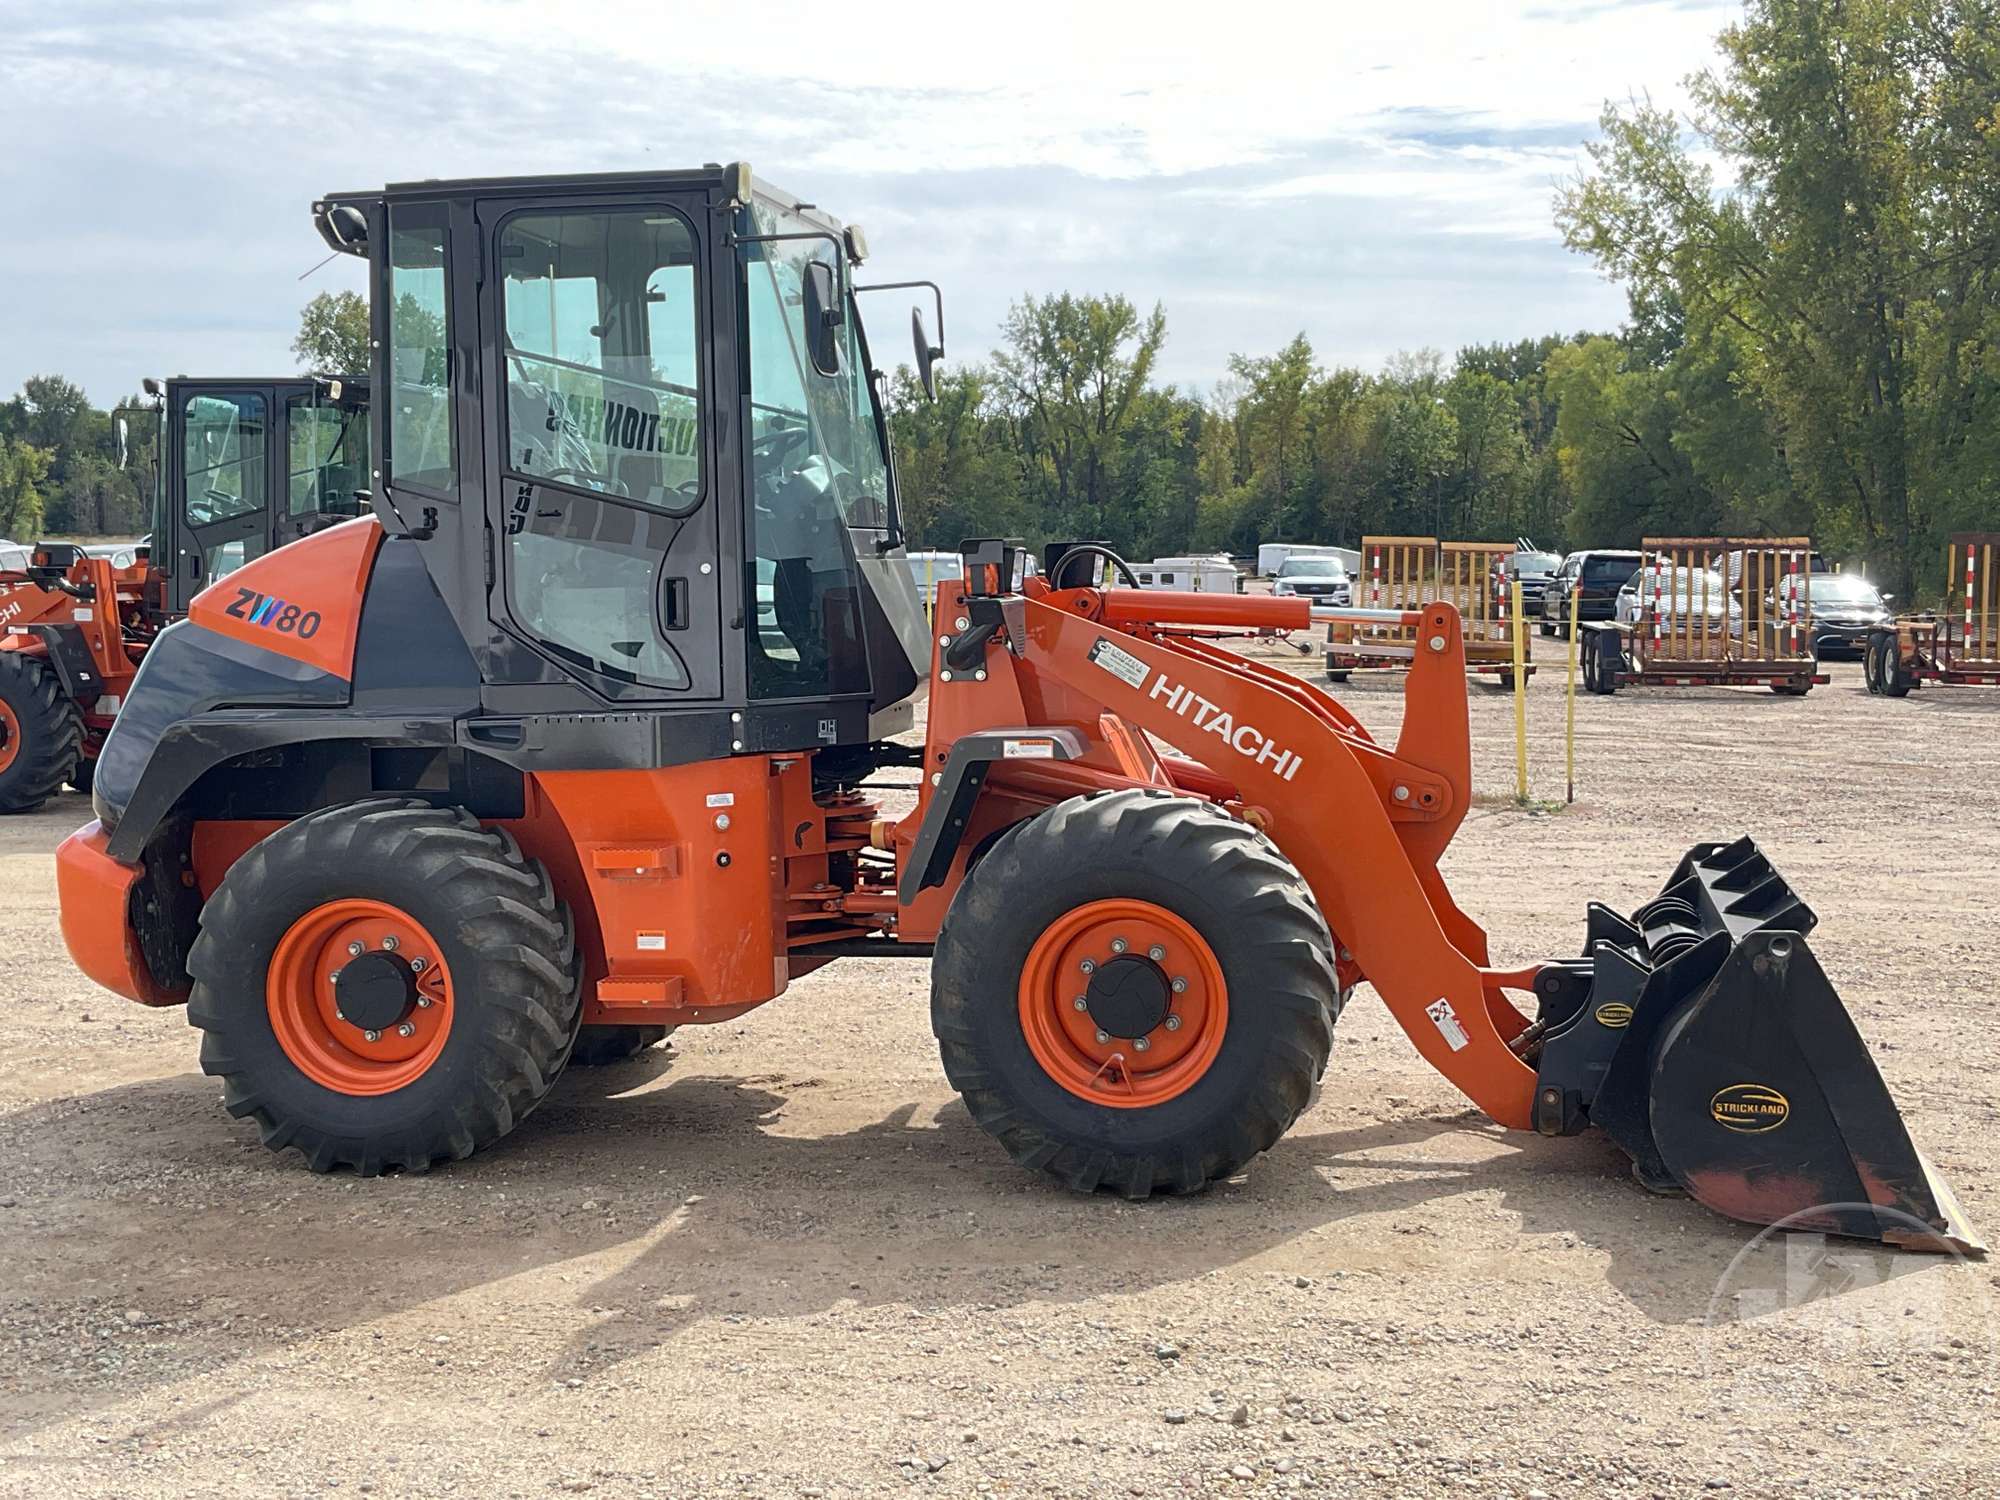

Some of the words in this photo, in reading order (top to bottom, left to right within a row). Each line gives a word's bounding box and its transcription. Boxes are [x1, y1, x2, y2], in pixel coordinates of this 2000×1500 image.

[225, 587, 321, 639] ZW80
[1149, 673, 1303, 782] HITACHI
[1715, 1103, 1785, 1115] STRICKLAND
